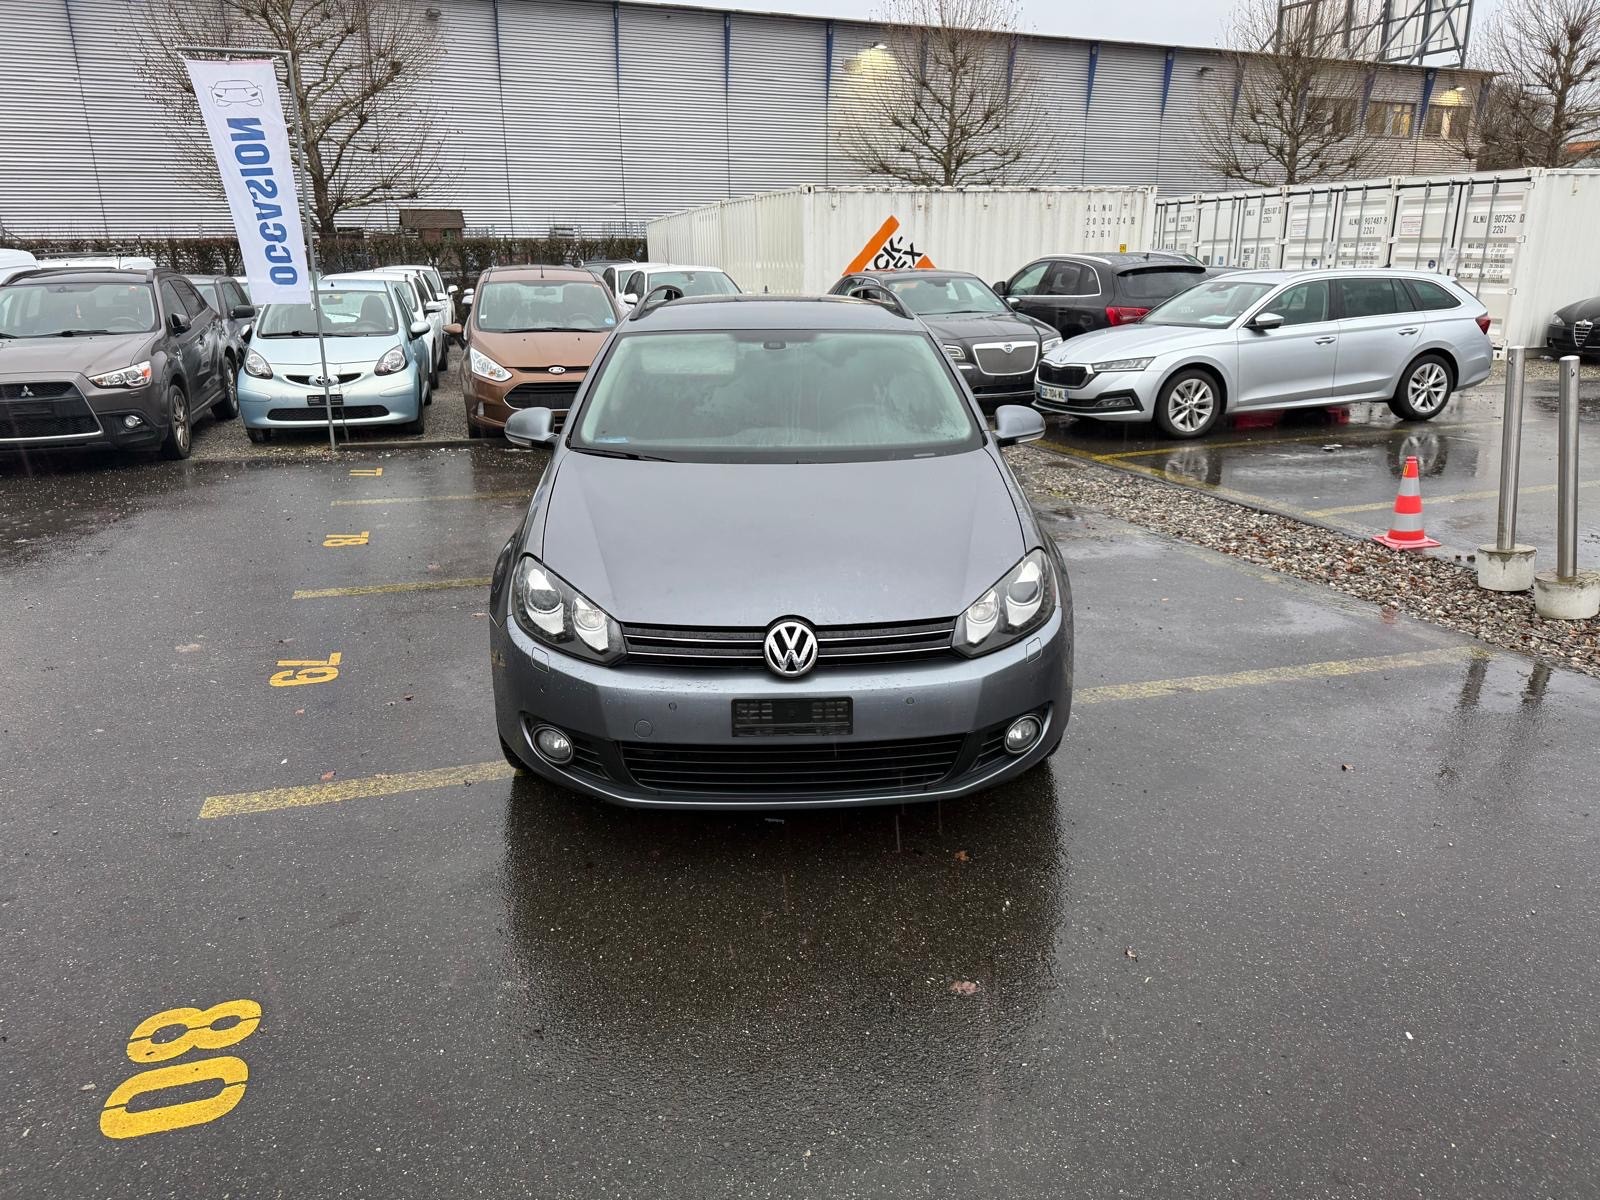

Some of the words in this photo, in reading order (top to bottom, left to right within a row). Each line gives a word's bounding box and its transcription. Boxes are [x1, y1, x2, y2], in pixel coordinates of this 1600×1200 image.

[1087, 204, 1113, 212] ALNU
[1472, 215, 1488, 223] ALNU
[1494, 214, 1516, 223] 907252
[322, 531, 370, 548] 78
[765, 621, 818, 676] VW
[269, 652, 342, 688] 79
[99, 998, 262, 1140] 80
